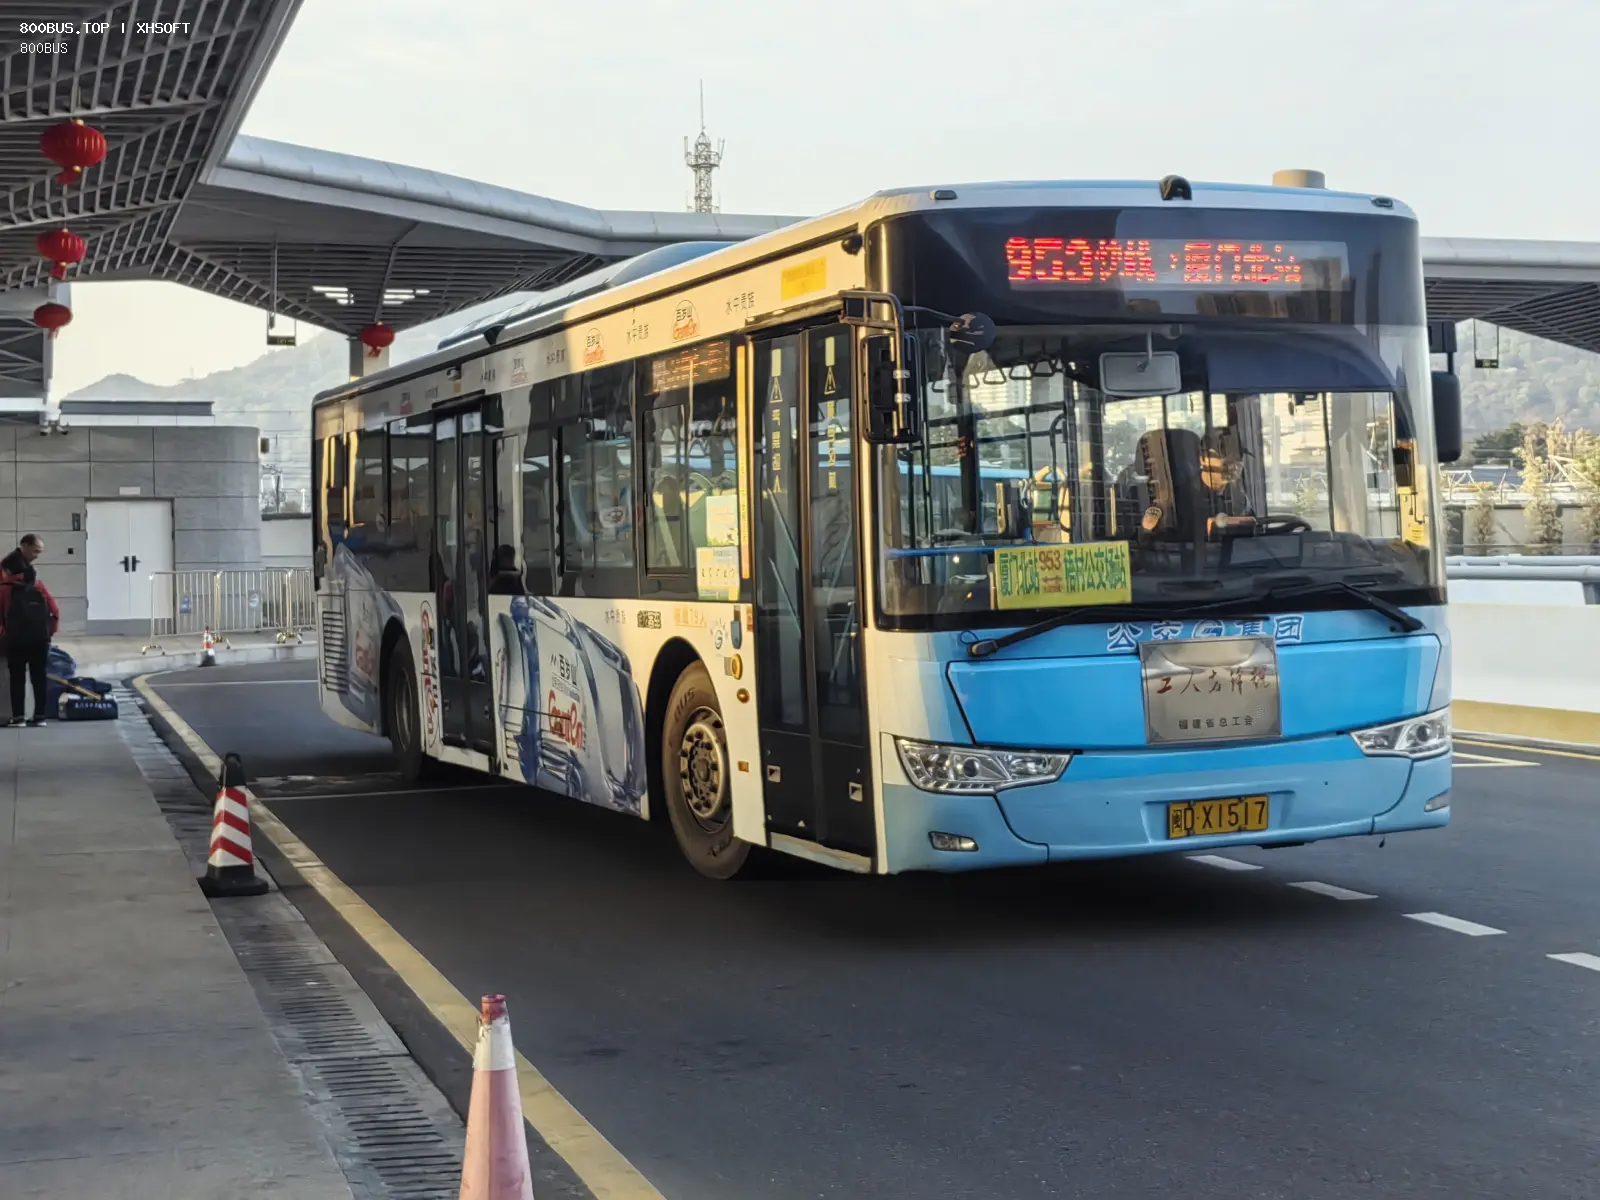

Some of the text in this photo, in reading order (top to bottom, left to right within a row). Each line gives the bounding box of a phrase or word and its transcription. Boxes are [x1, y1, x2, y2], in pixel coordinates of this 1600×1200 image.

[1039, 550, 1061, 571] 953
[1178, 714, 1254, 731] 福建省总工会
